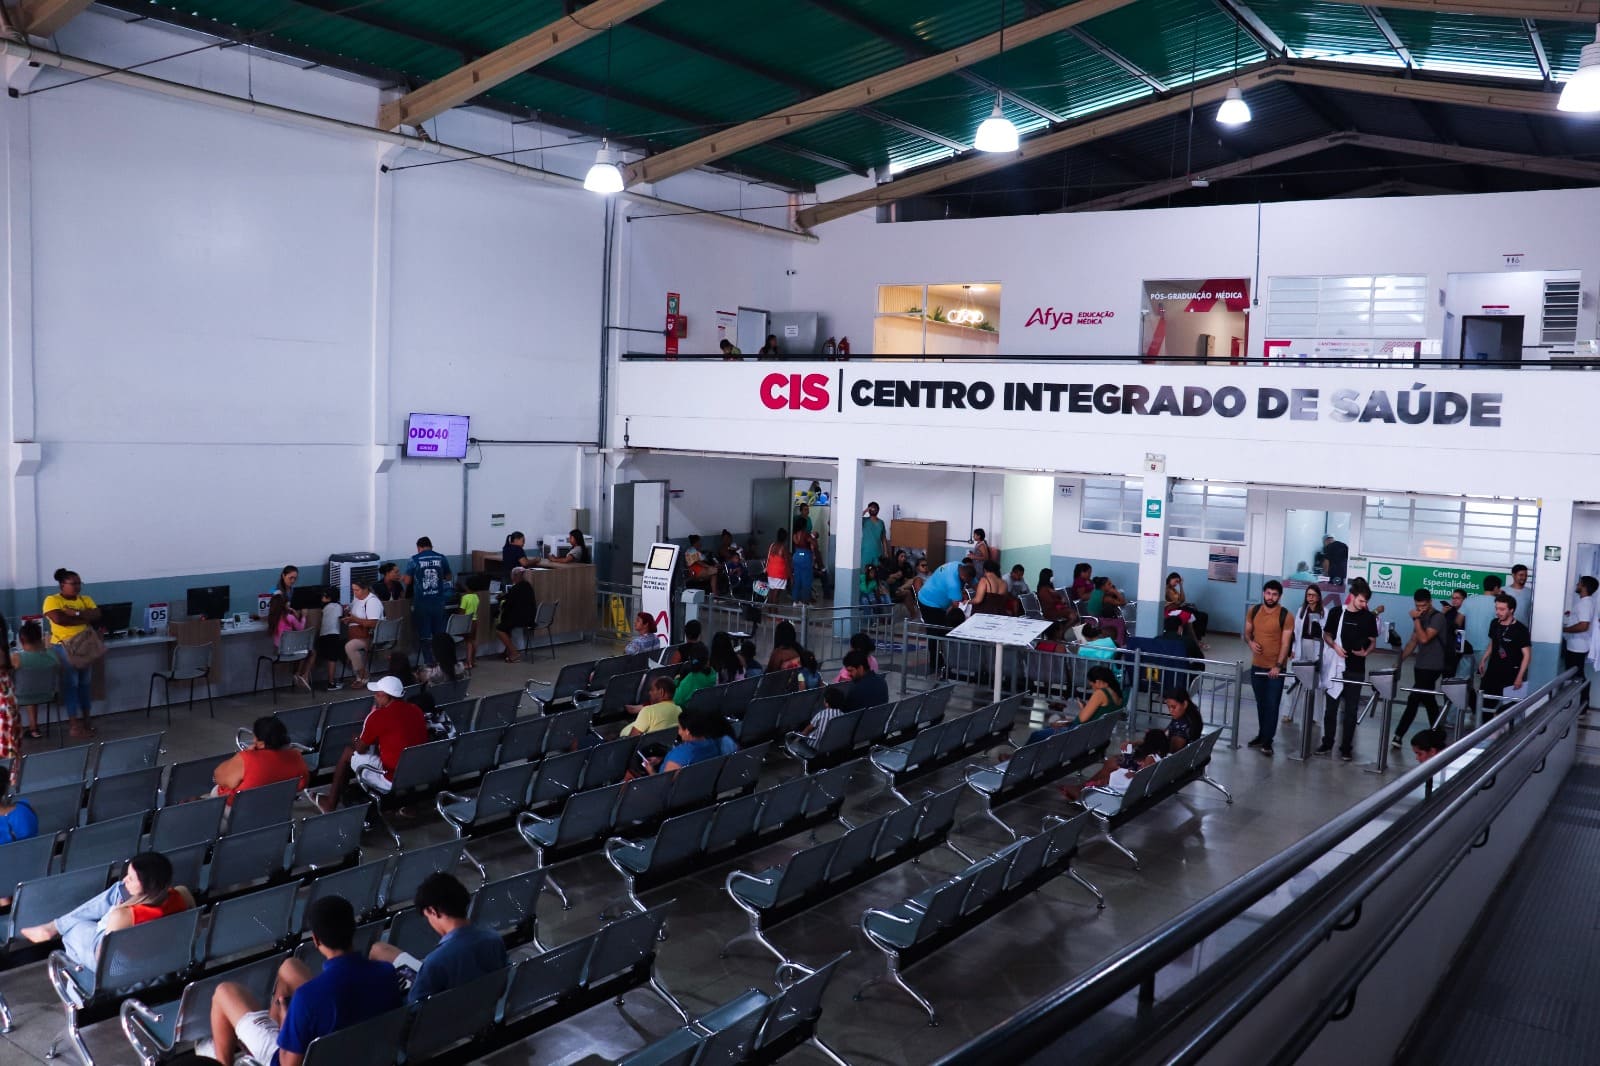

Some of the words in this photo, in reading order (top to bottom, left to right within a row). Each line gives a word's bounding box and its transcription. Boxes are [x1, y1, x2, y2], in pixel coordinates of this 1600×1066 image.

[1150, 291, 1212, 301] PÓS-GRADUAÇÃO
[1215, 291, 1243, 299] MÉDICA
[1024, 307, 1073, 330] Afya
[1078, 310, 1115, 319] EDUCAÇÃO
[760, 373, 830, 411] CIS
[851, 379, 995, 410] CENTRO
[1003, 382, 1247, 418] INTEGRADO
[1257, 387, 1319, 421] DE
[1329, 381, 1503, 428] SAÚDE
[409, 427, 449, 440] ODO40
[1432, 569, 1459, 579] Centro
[1461, 571, 1471, 580] de
[1423, 577, 1480, 590] Especialidades
[151, 610, 166, 621] 05
